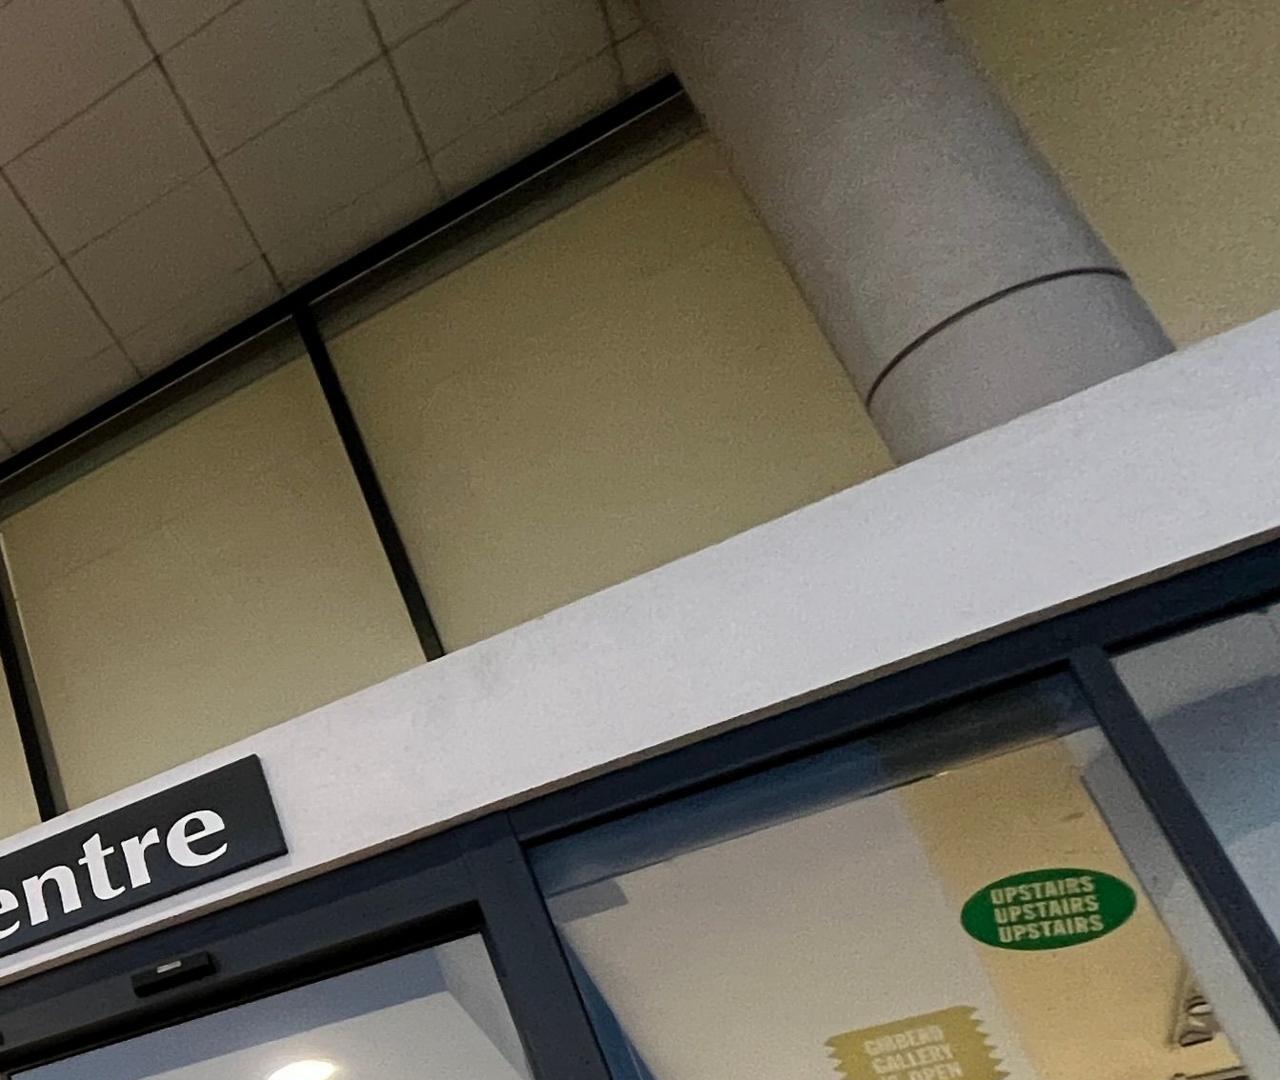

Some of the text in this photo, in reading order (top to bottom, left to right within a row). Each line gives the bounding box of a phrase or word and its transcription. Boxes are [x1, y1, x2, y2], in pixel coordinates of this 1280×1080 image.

[991, 876, 1095, 904] UPSTAIRS
[994, 895, 1099, 924] UPSTAIRS
[999, 914, 1104, 943] UPSTAIRS
[872, 1044, 953, 1074] GALLERY
